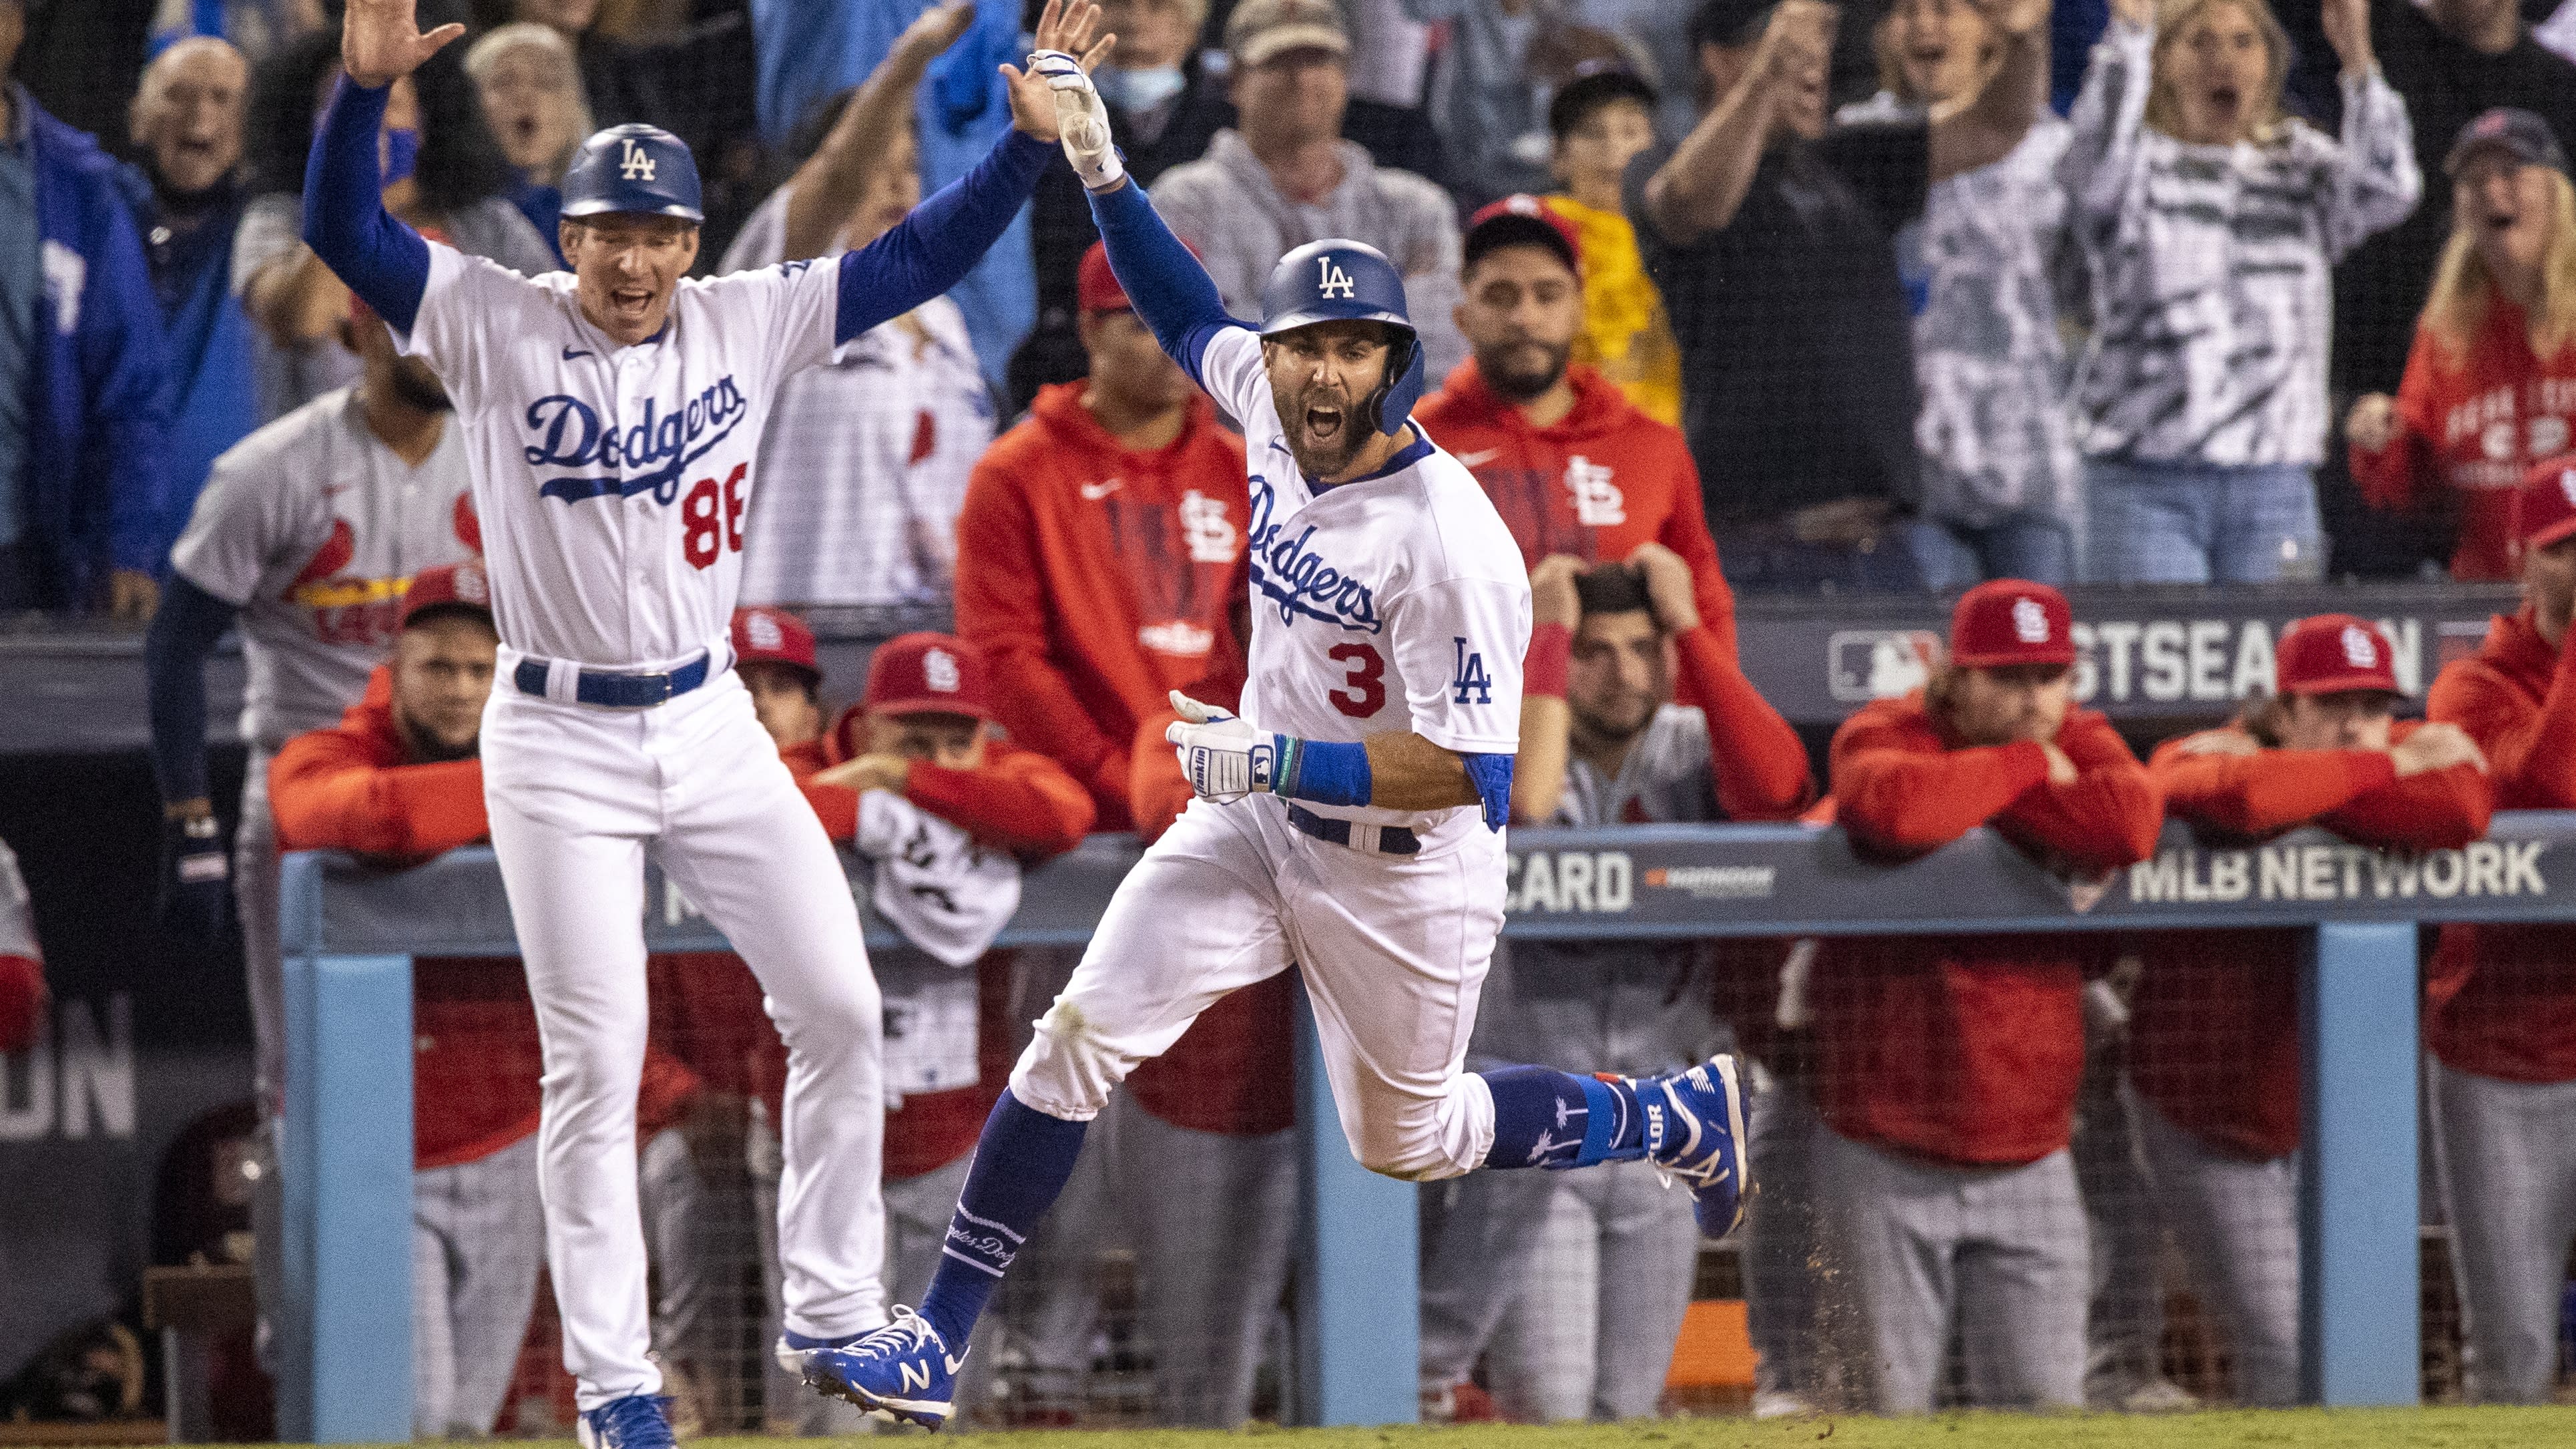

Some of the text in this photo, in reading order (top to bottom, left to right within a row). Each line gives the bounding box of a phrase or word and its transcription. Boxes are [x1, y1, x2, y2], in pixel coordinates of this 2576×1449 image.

[619, 139, 656, 181] LA
[1318, 256, 1354, 299] LA
[525, 374, 747, 505] Dodgers
[1328, 642, 1386, 718] 3
[1453, 636, 1491, 704] LA
[2129, 847, 2250, 901] MLB
